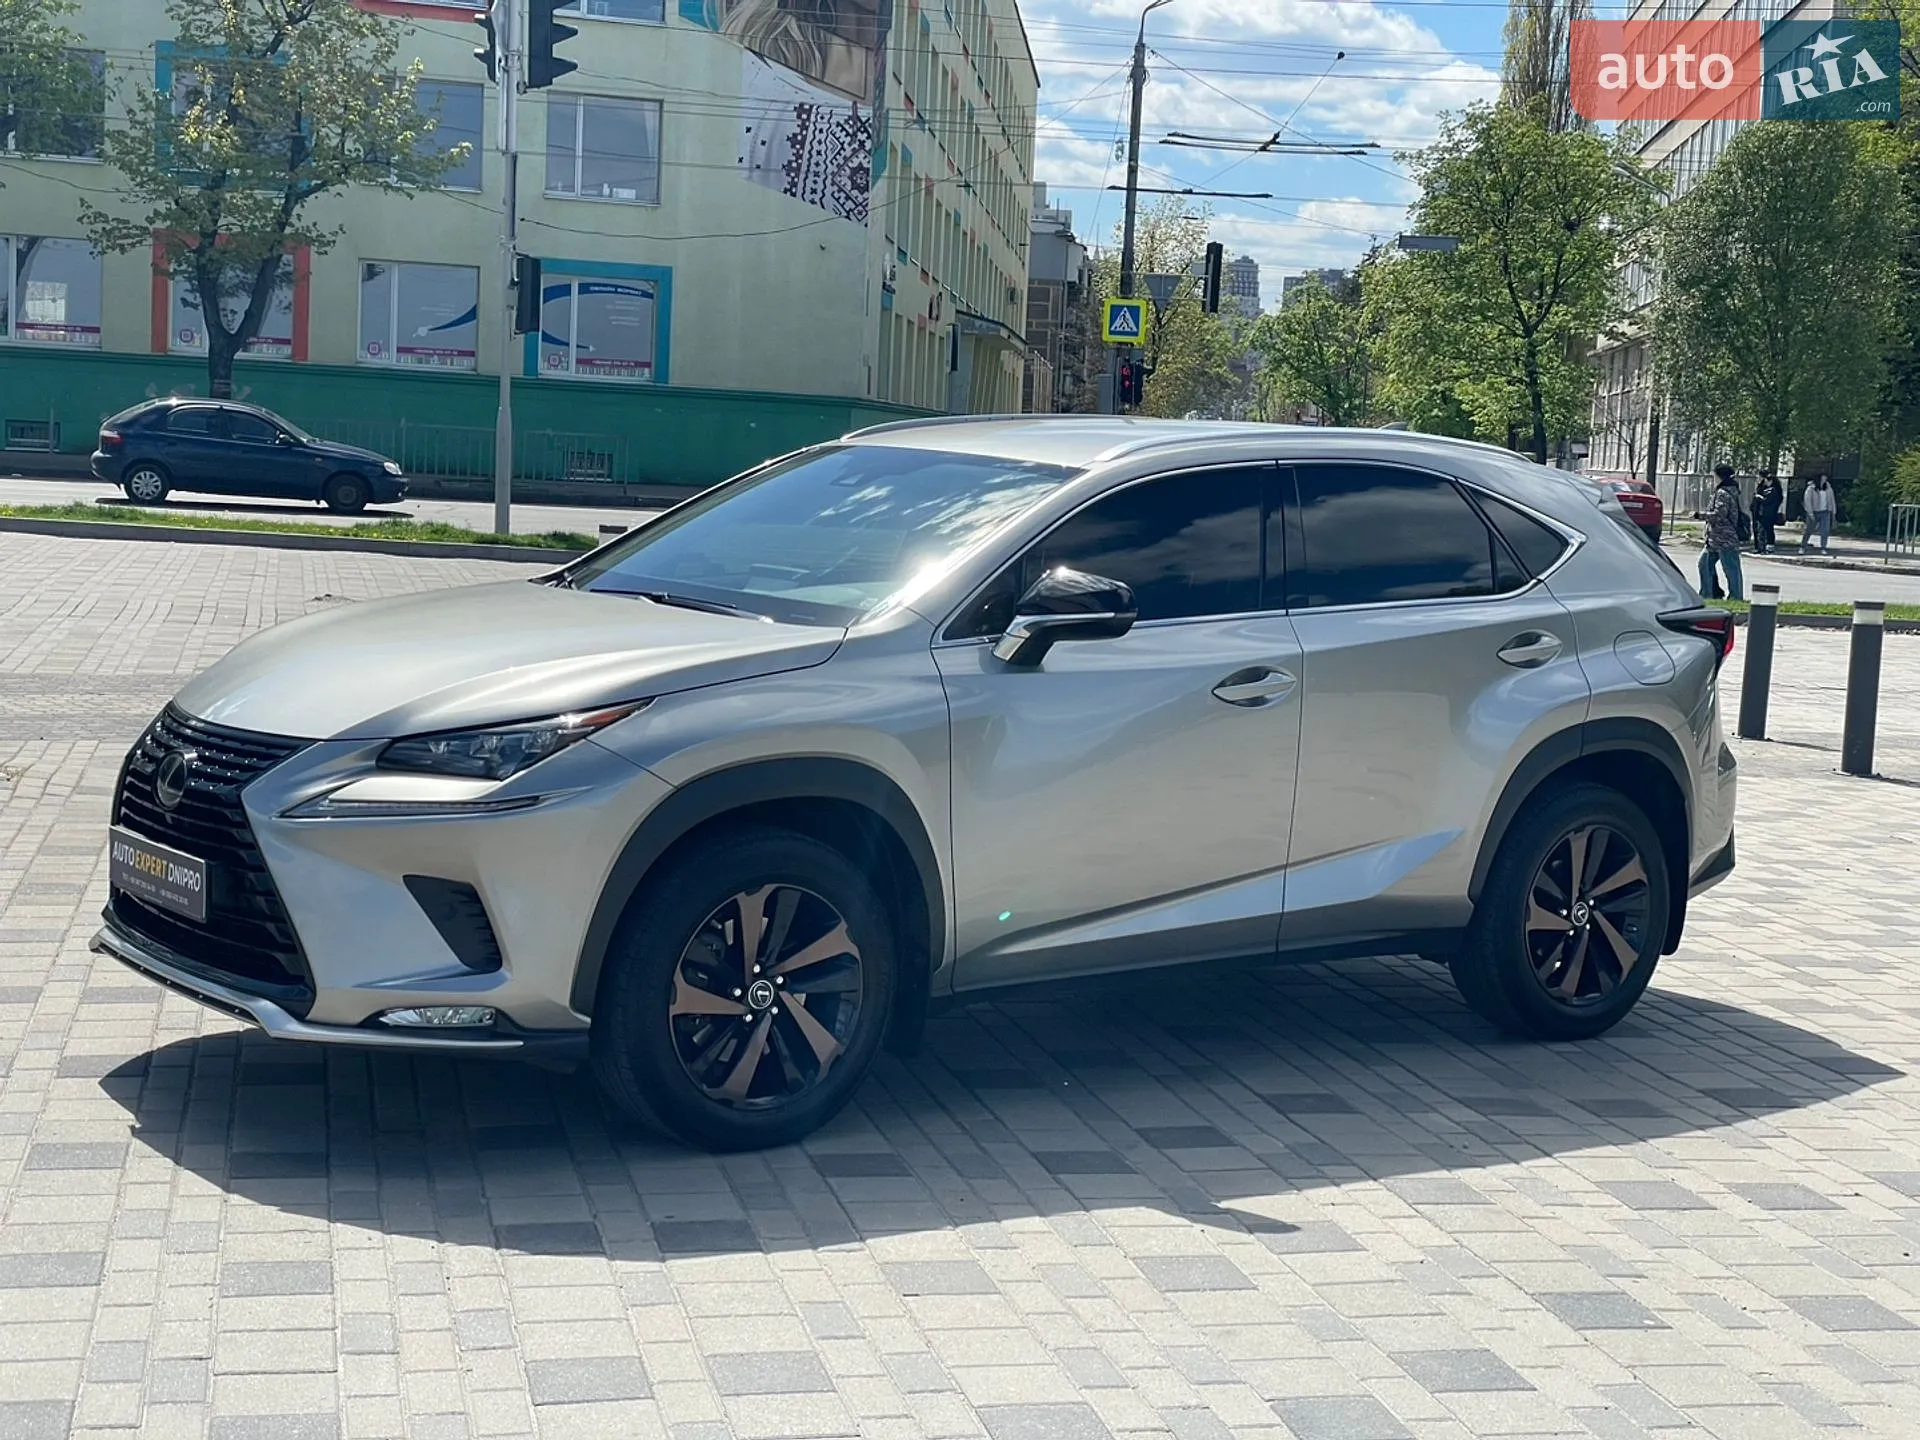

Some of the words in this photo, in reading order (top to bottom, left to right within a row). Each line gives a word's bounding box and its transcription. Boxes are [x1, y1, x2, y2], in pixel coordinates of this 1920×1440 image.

[112, 841, 135, 866] AUTO
[135, 849, 168, 880] EXPERT
[168, 862, 201, 893] DNIPRO
